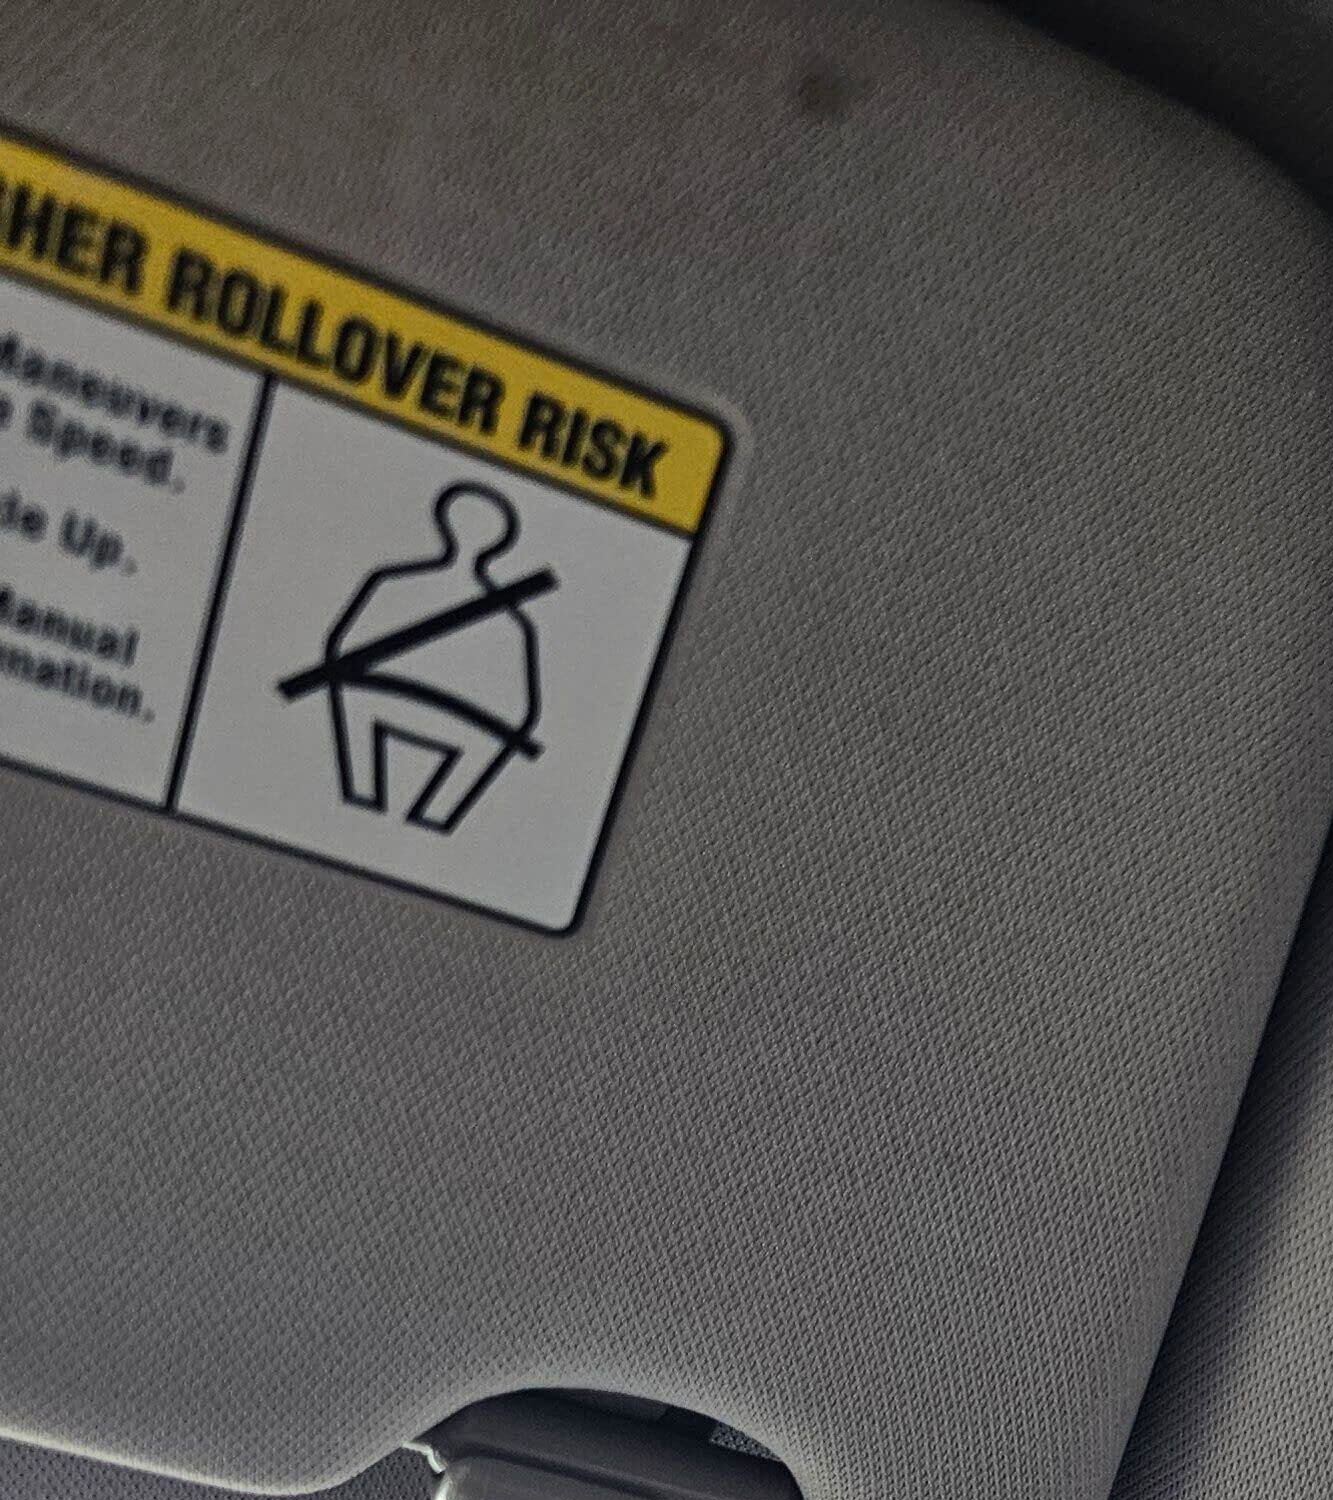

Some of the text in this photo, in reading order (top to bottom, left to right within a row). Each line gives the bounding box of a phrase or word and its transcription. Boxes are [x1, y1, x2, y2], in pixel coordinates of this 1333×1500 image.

[0, 176, 670, 501] HER ROLLOVER RISK
